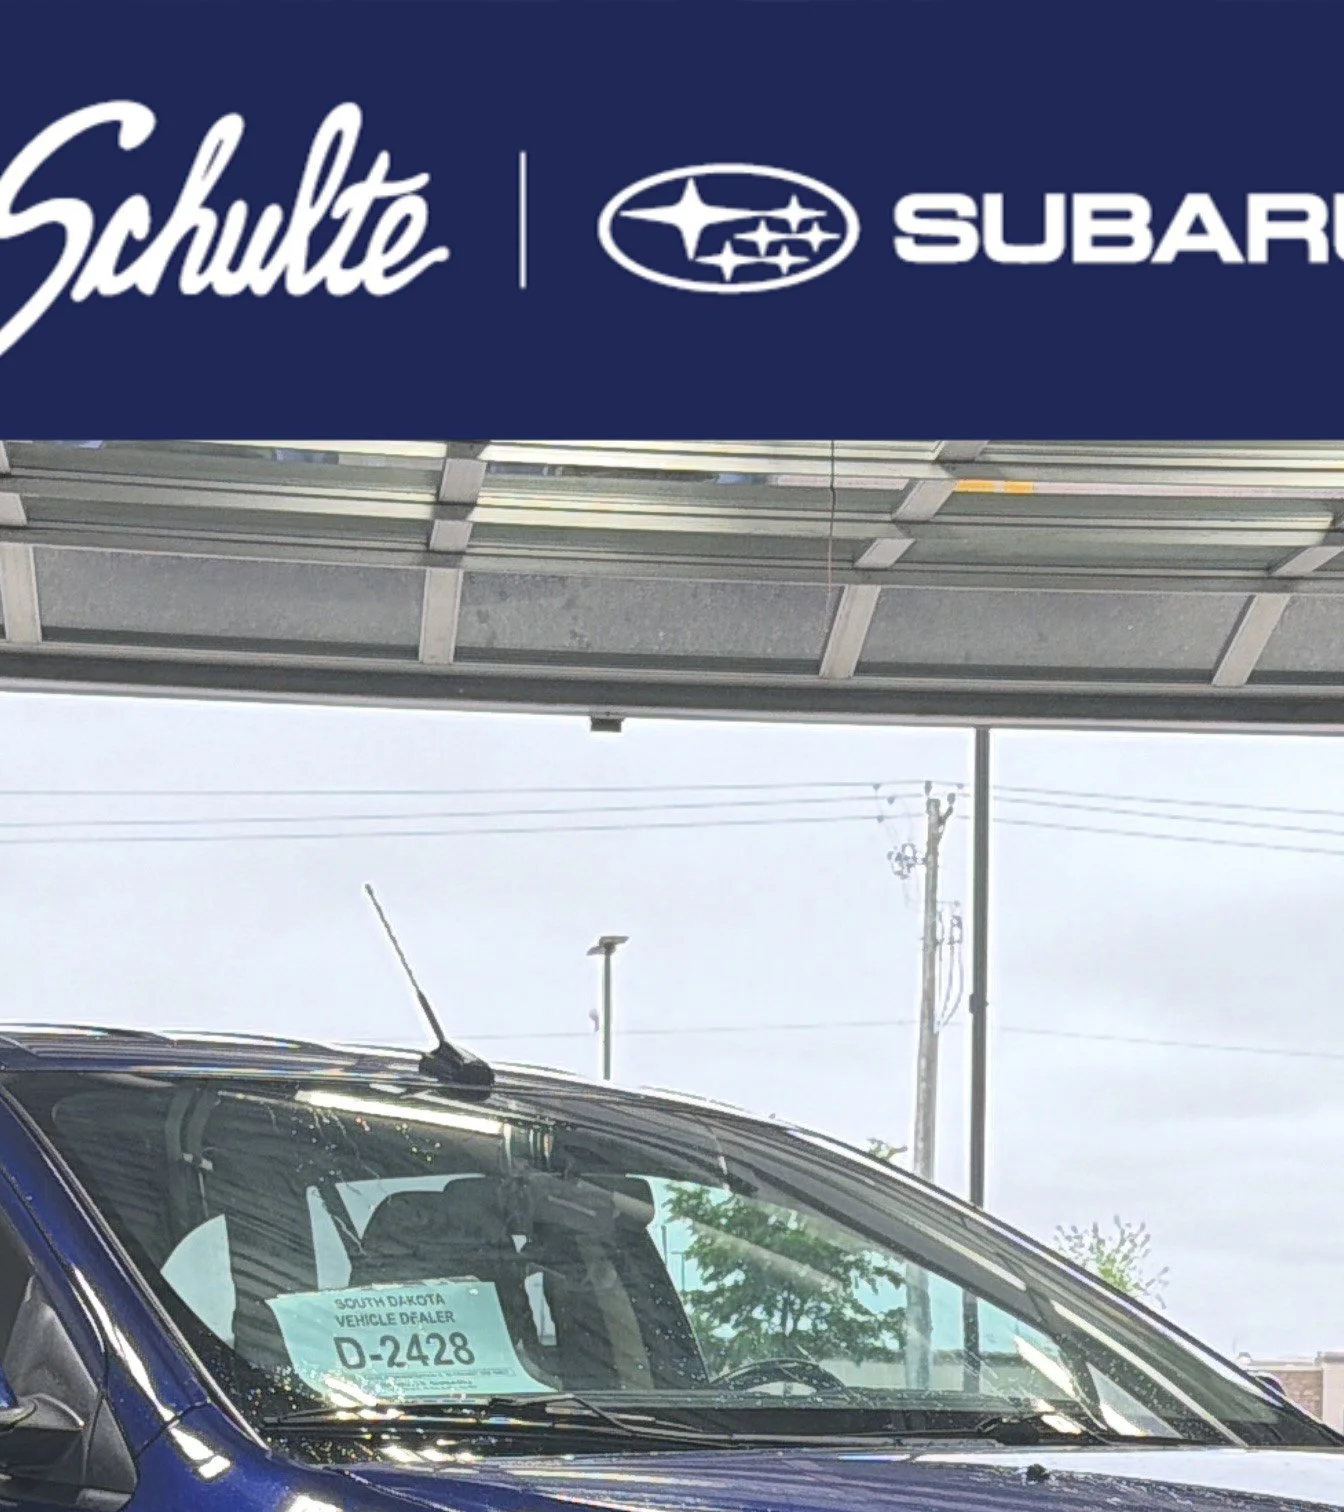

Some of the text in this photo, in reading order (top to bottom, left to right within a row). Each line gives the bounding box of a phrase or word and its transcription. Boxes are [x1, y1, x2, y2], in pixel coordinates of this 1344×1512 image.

[334, 1293, 446, 1311] SOUTH DAKOTA
[334, 1309, 456, 1329] VEHICLE DEALER
[332, 1331, 476, 1370] D-2428
